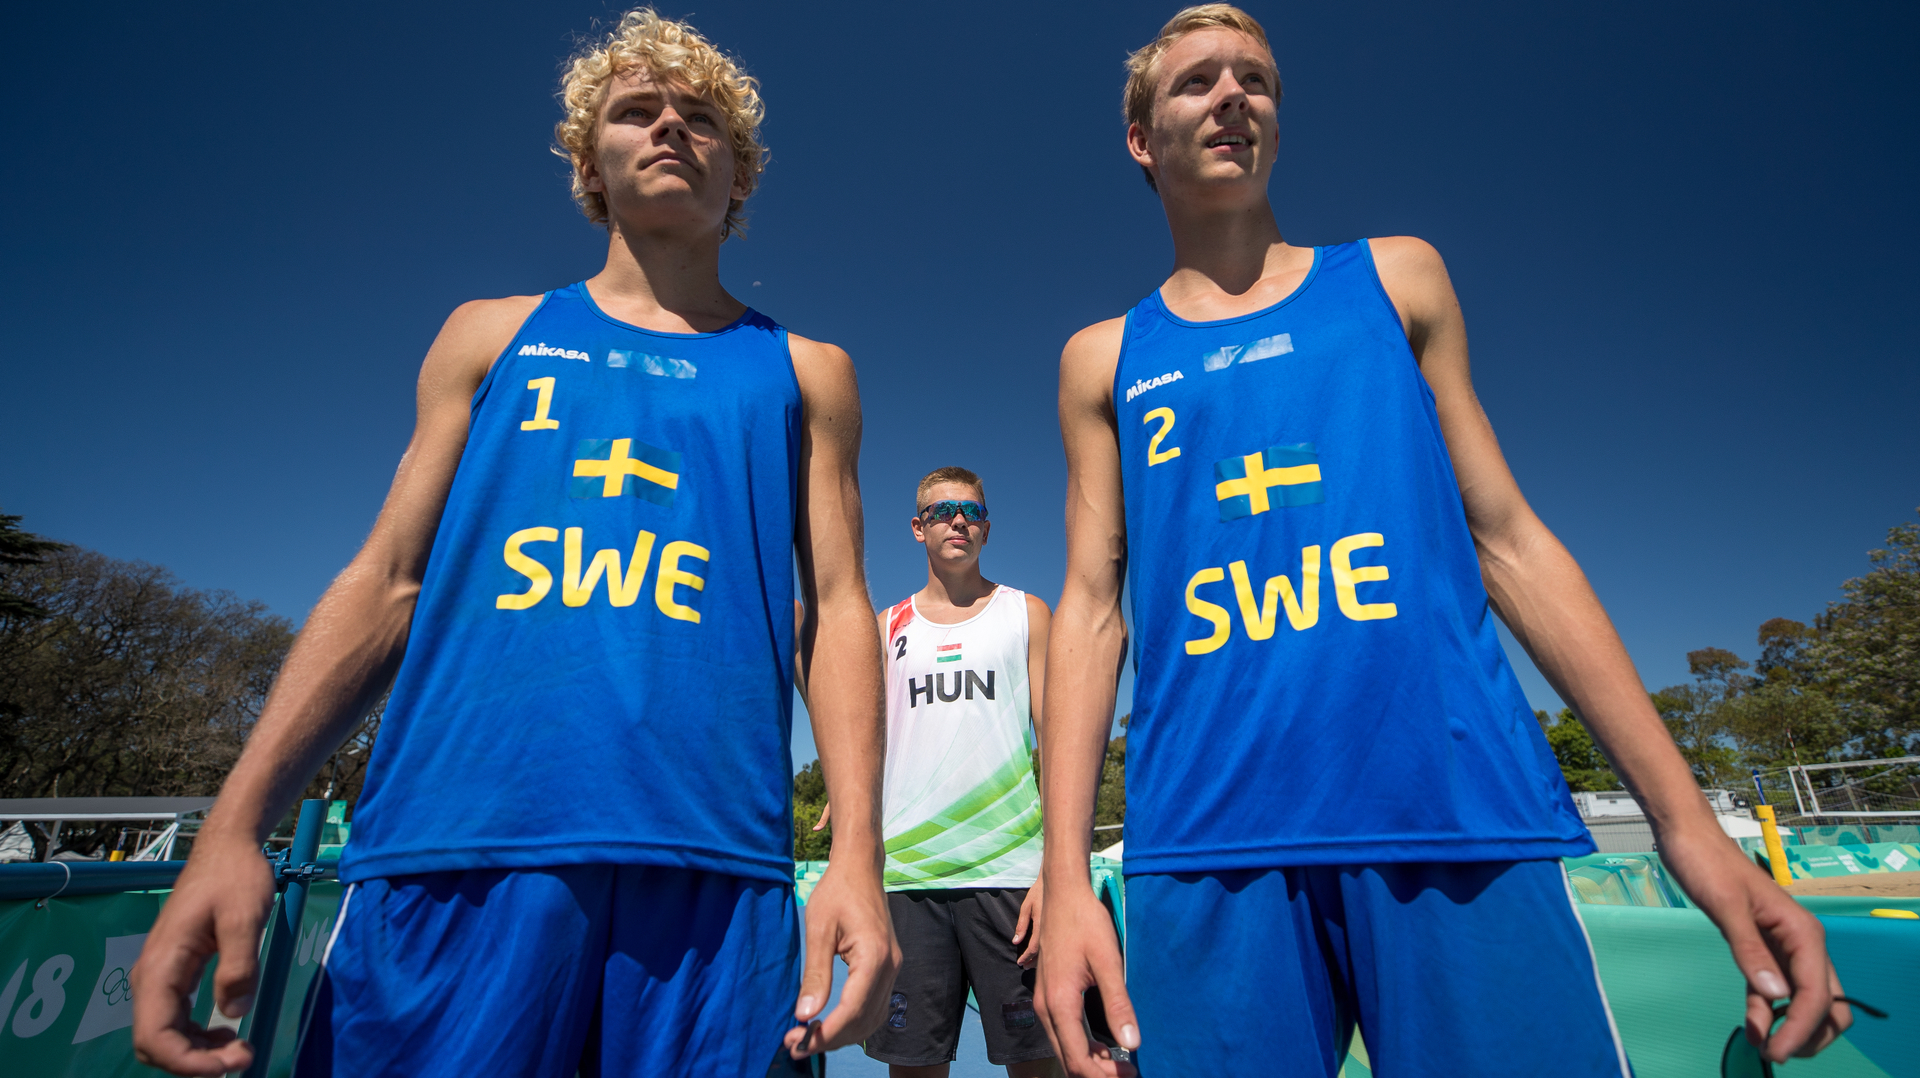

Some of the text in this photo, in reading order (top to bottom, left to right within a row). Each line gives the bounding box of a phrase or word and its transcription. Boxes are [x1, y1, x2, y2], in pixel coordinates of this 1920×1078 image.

[520, 377, 560, 431] 1
[1143, 406, 1181, 467] 2
[496, 526, 710, 624] SWE
[1185, 532, 1398, 655] SWE
[895, 635, 907, 661] 2
[908, 669, 995, 708] HUN
[888, 993, 907, 1028] 2
